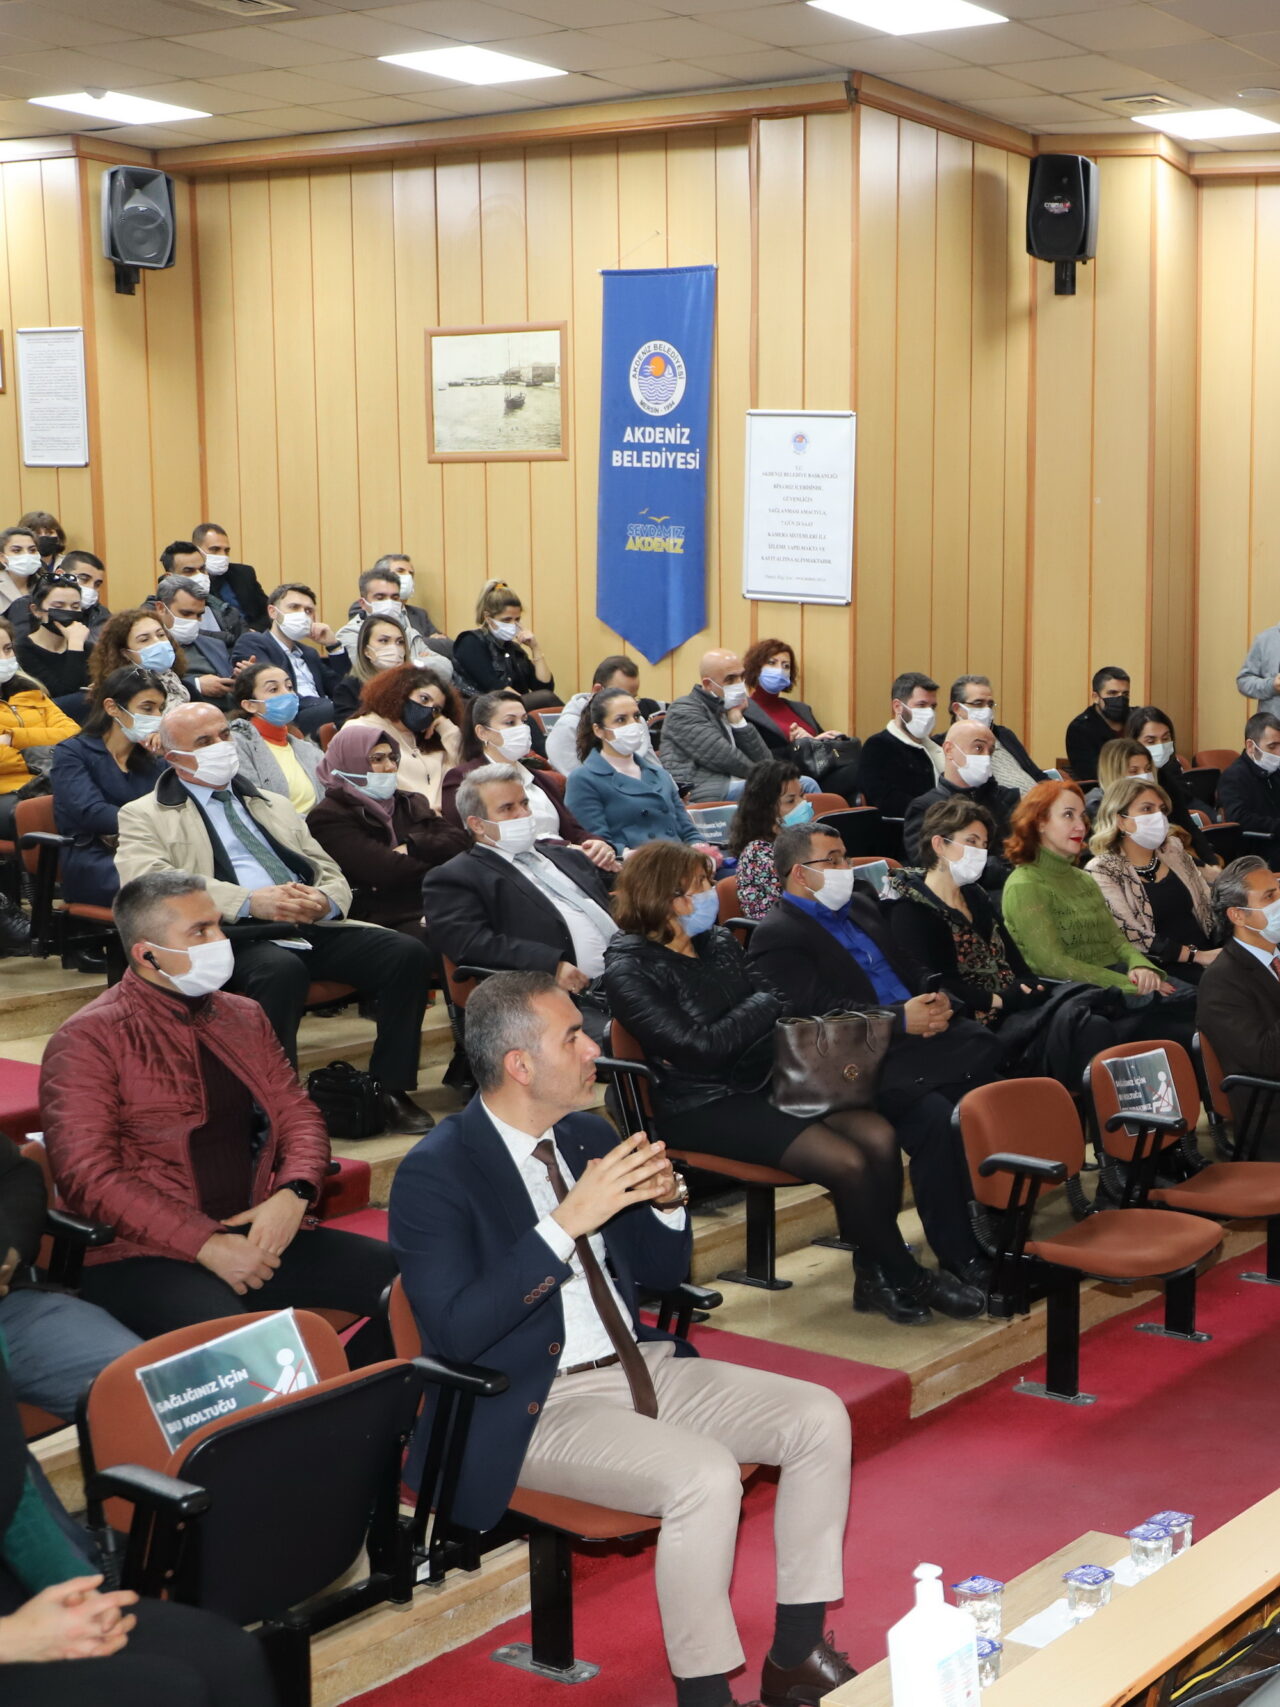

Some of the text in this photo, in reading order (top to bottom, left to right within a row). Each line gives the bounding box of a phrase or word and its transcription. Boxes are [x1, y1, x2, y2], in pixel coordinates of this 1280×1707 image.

[632, 343, 685, 380] AKDENİZ BELEDİYESİ
[623, 423, 691, 445] AKDENİZ
[612, 447, 700, 470] BELEDİYESİ
[626, 523, 686, 538] SEVDAMIZ
[155, 1367, 249, 1414] SAĞLIĞINIZ İÇİN
[165, 1397, 238, 1435] BU KOLTUĞU
